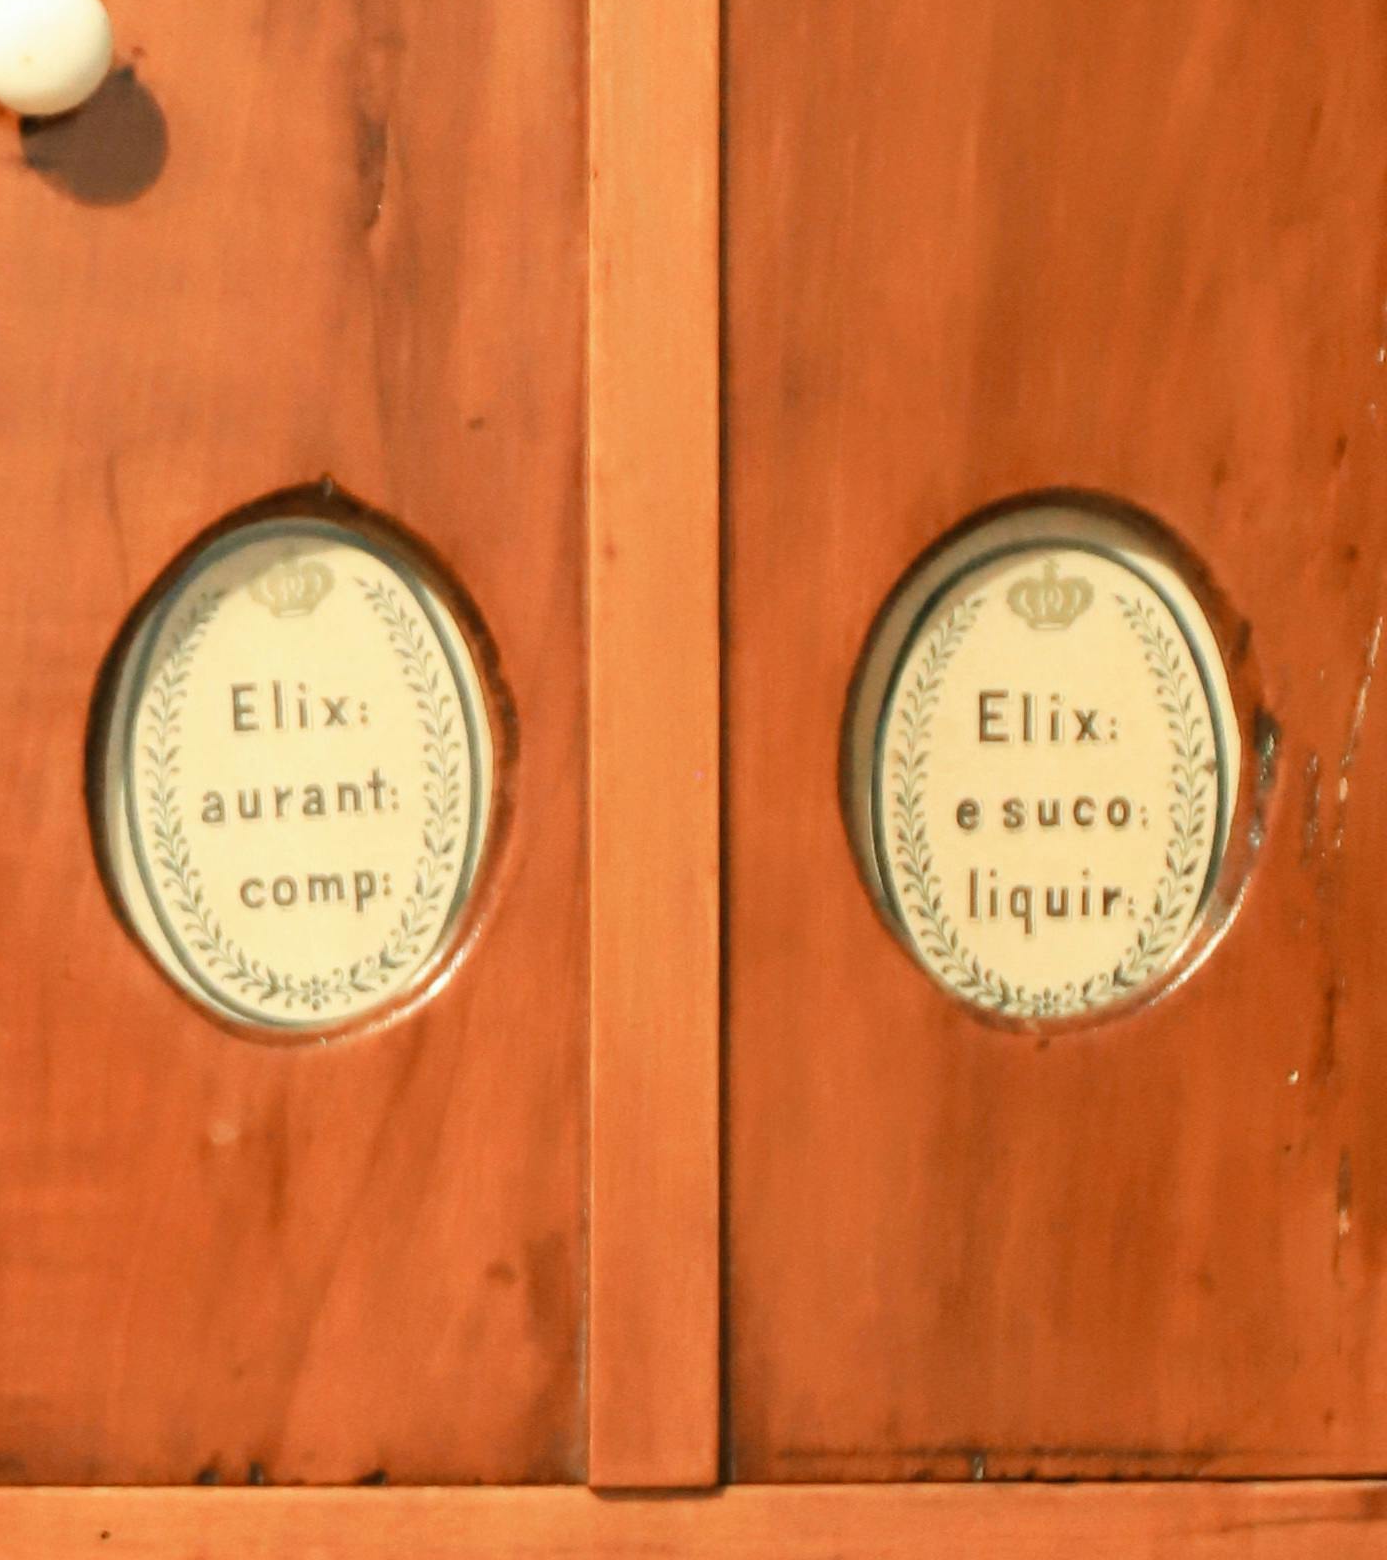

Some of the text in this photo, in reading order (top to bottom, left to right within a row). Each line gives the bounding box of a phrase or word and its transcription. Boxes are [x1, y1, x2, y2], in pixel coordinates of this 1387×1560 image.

[231, 680, 370, 732] Elix:
[978, 690, 1118, 742] Elix:
[201, 768, 400, 823] aurant:
[956, 793, 1150, 831] e suco:
[239, 867, 392, 913] comp:
[968, 869, 1138, 934] liquir:
